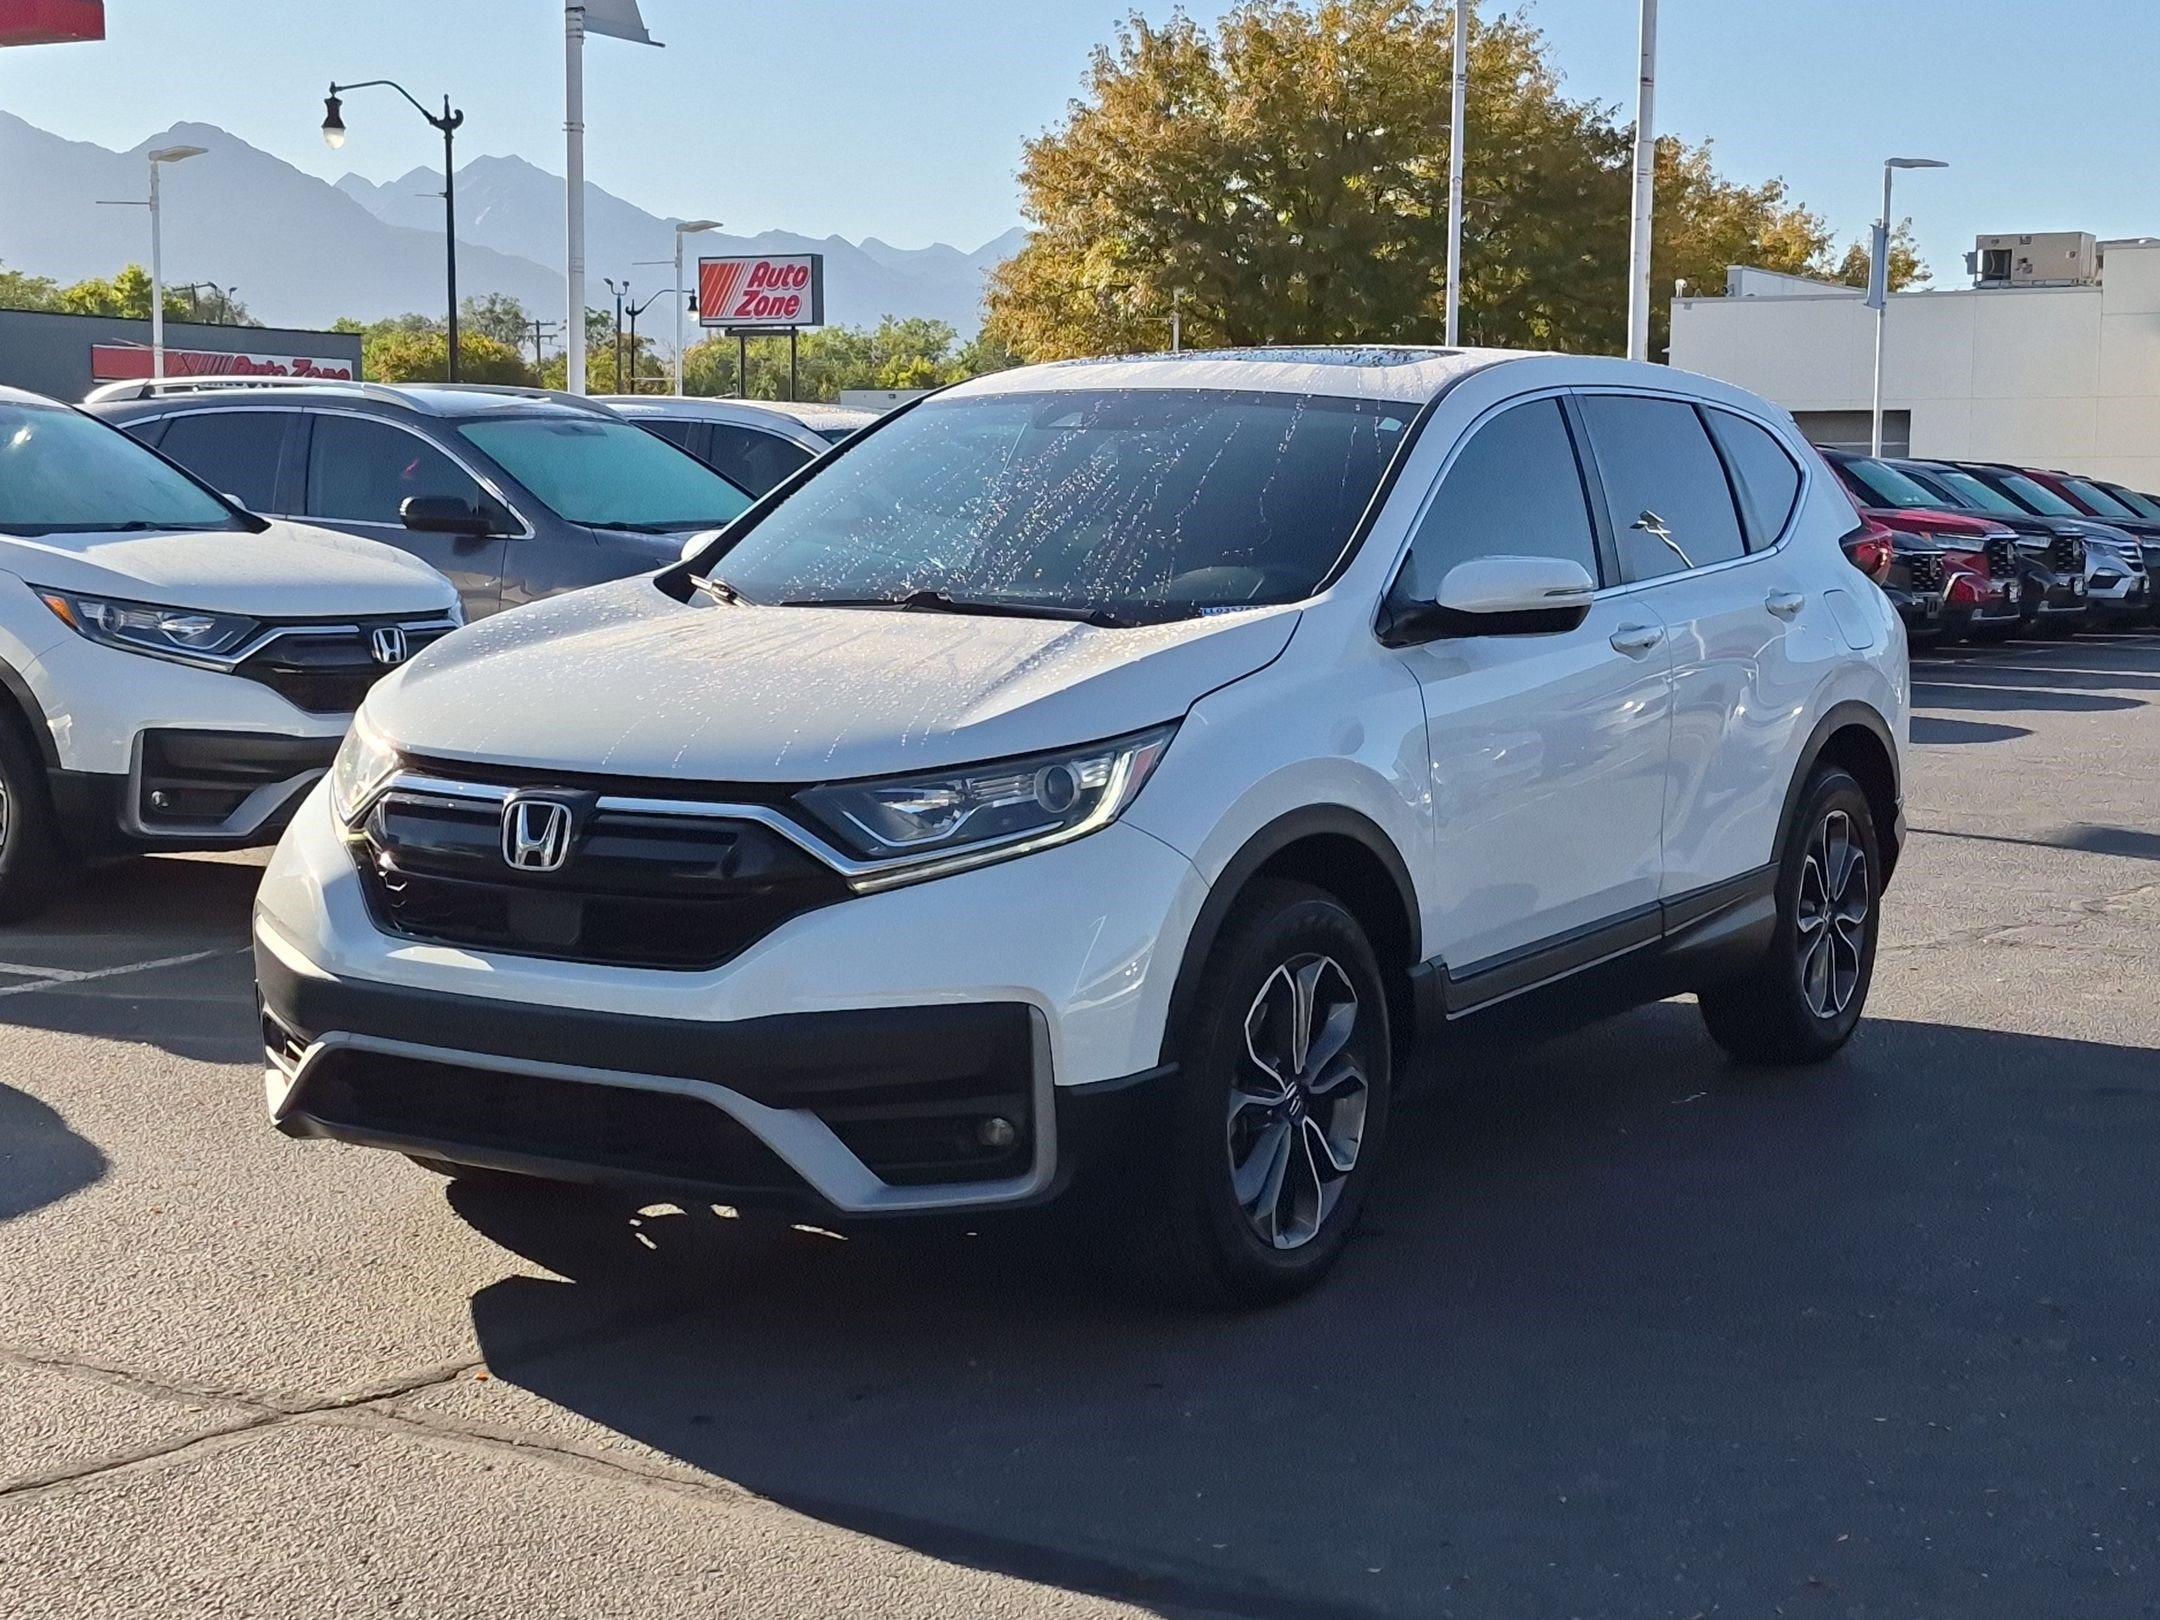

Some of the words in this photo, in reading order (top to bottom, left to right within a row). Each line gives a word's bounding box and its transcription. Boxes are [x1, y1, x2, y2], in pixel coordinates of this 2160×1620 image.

[747, 261, 809, 290] Auto
[734, 290, 801, 318] Zone
[232, 355, 288, 376] Auto
